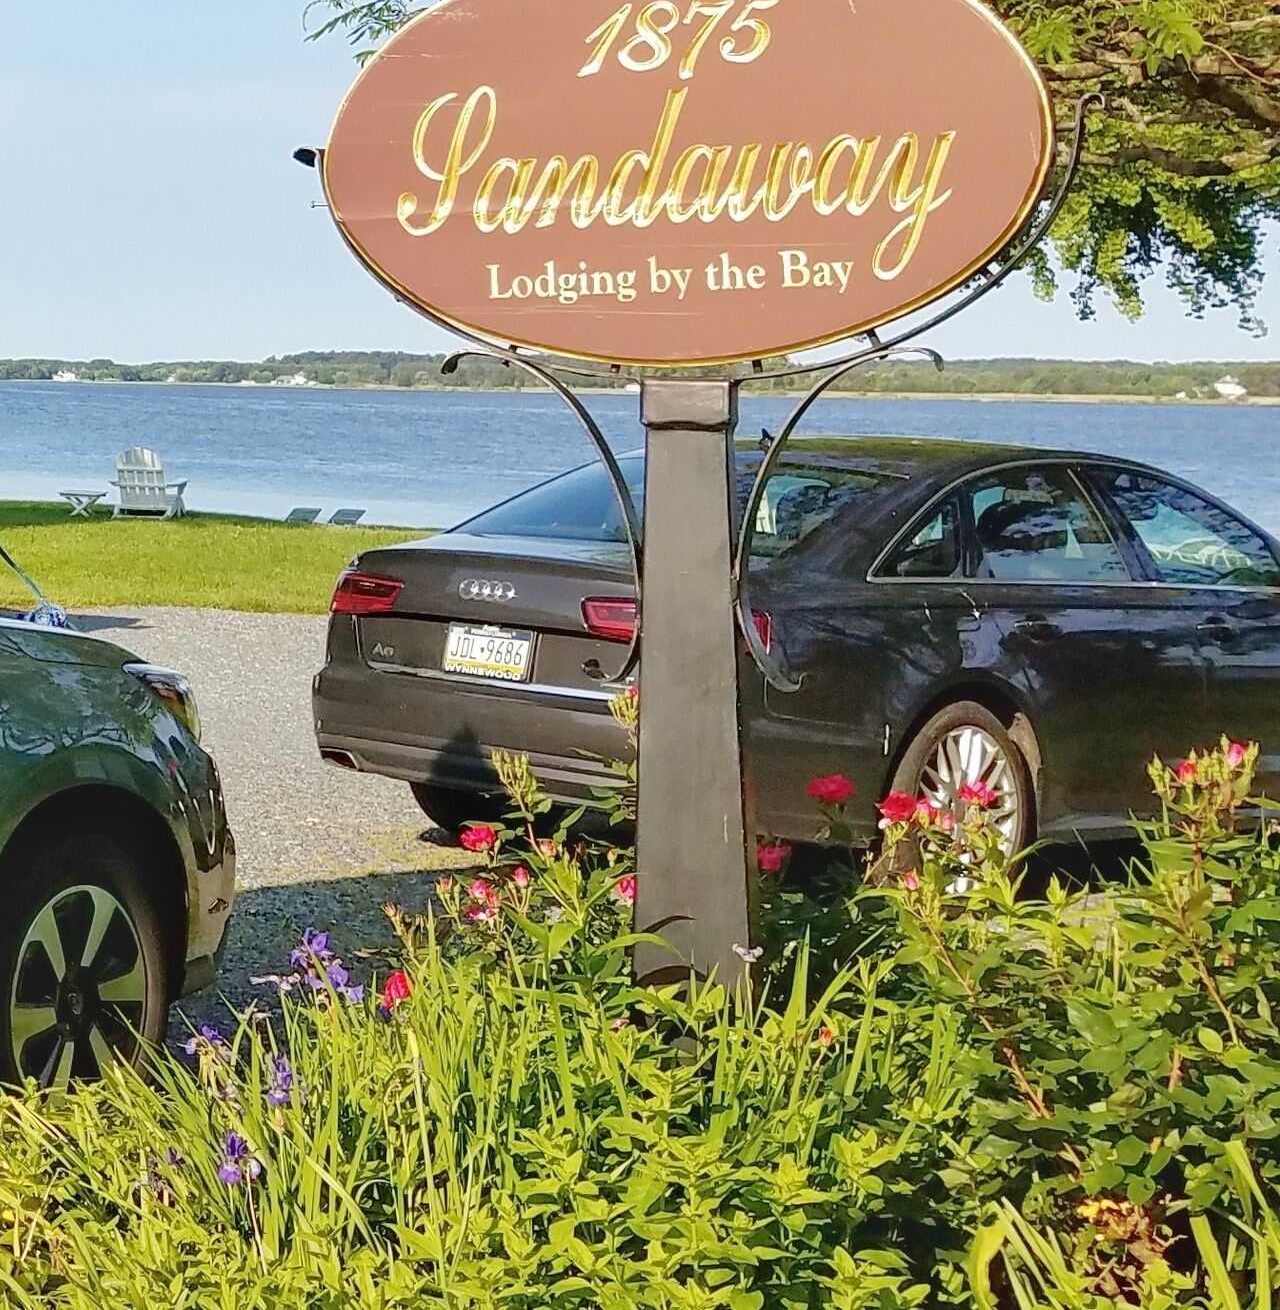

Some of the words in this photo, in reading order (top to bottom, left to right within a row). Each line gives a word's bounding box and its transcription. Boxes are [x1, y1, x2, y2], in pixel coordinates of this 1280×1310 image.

[396, 85, 958, 281] Sandaway
[486, 260, 638, 304] Lodging
[647, 255, 693, 300] by
[705, 252, 766, 291] the
[778, 249, 854, 294] Bay
[445, 662, 521, 681] WYNNEWOOD
